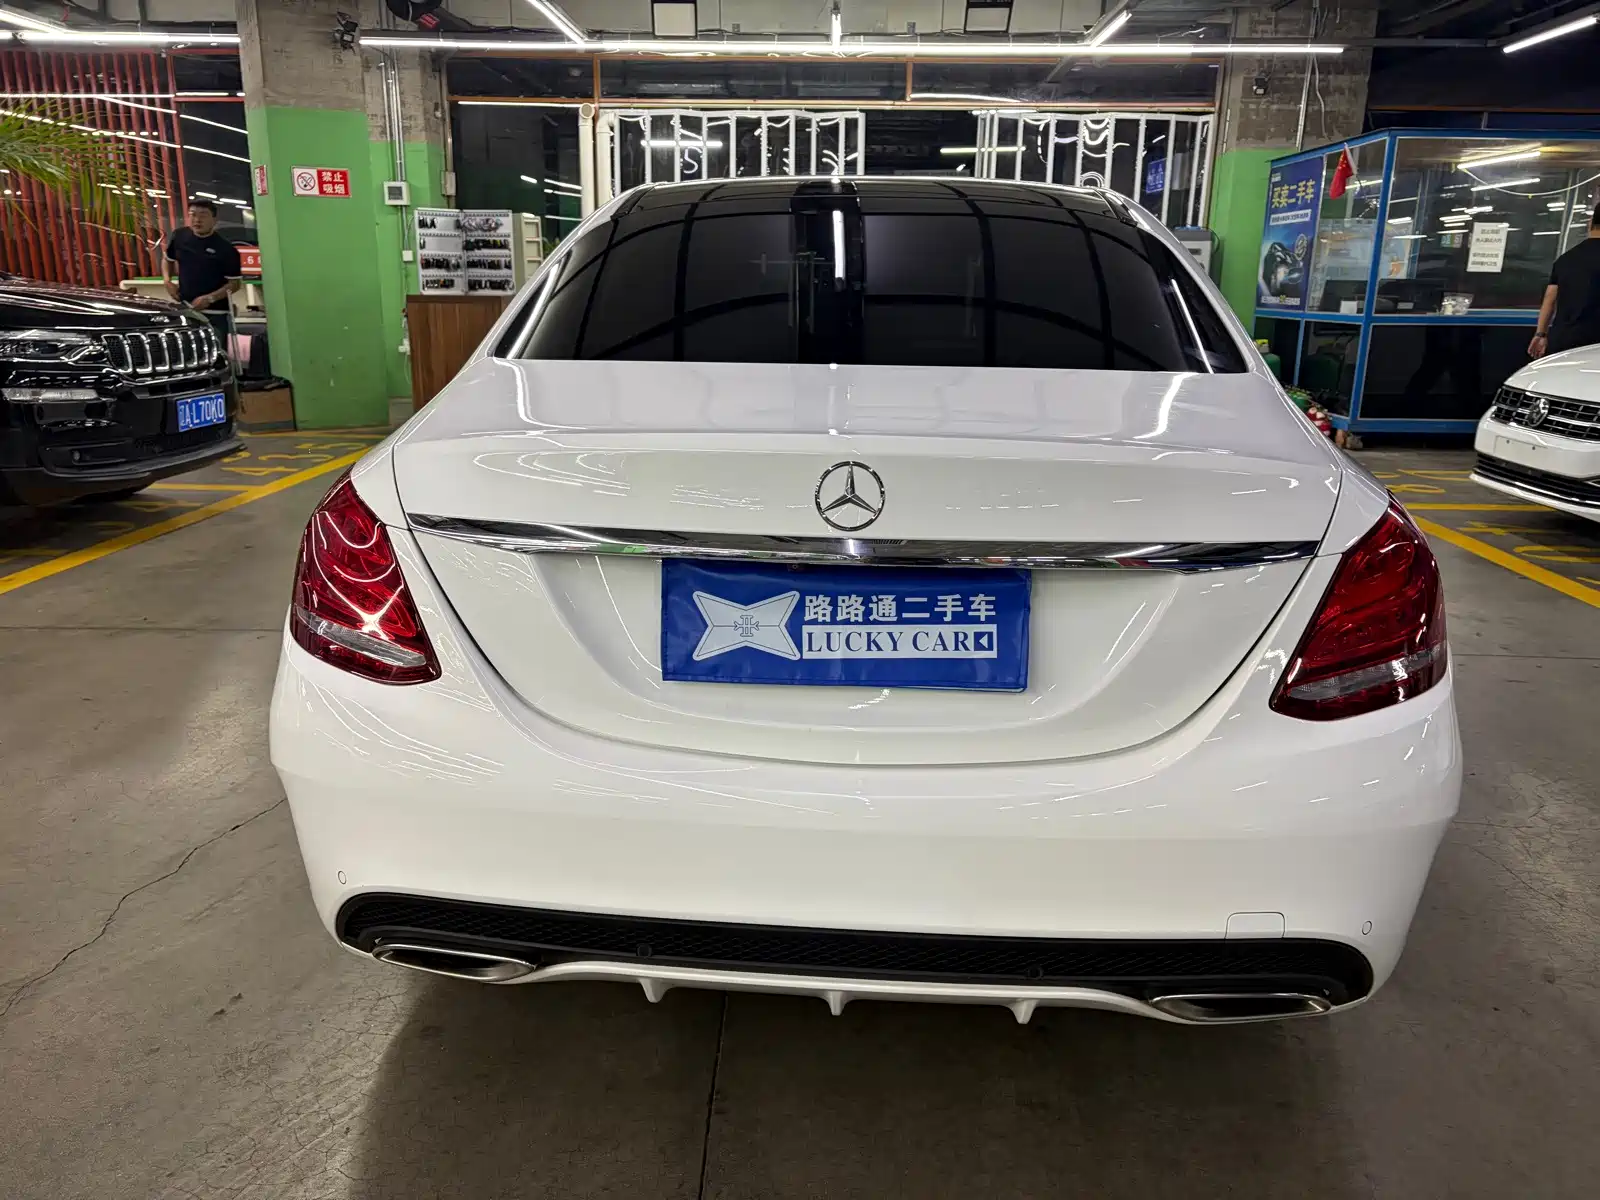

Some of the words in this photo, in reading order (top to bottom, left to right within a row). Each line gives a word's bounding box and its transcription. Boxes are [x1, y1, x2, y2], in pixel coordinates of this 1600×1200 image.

[321, 171, 345, 182] 禁止
[322, 183, 346, 194] 吸烟
[1271, 179, 1316, 208] 买卖二手车
[804, 594, 996, 622] 路路通二手车
[806, 631, 903, 653] LUCKY
[911, 630, 970, 653] CAR
